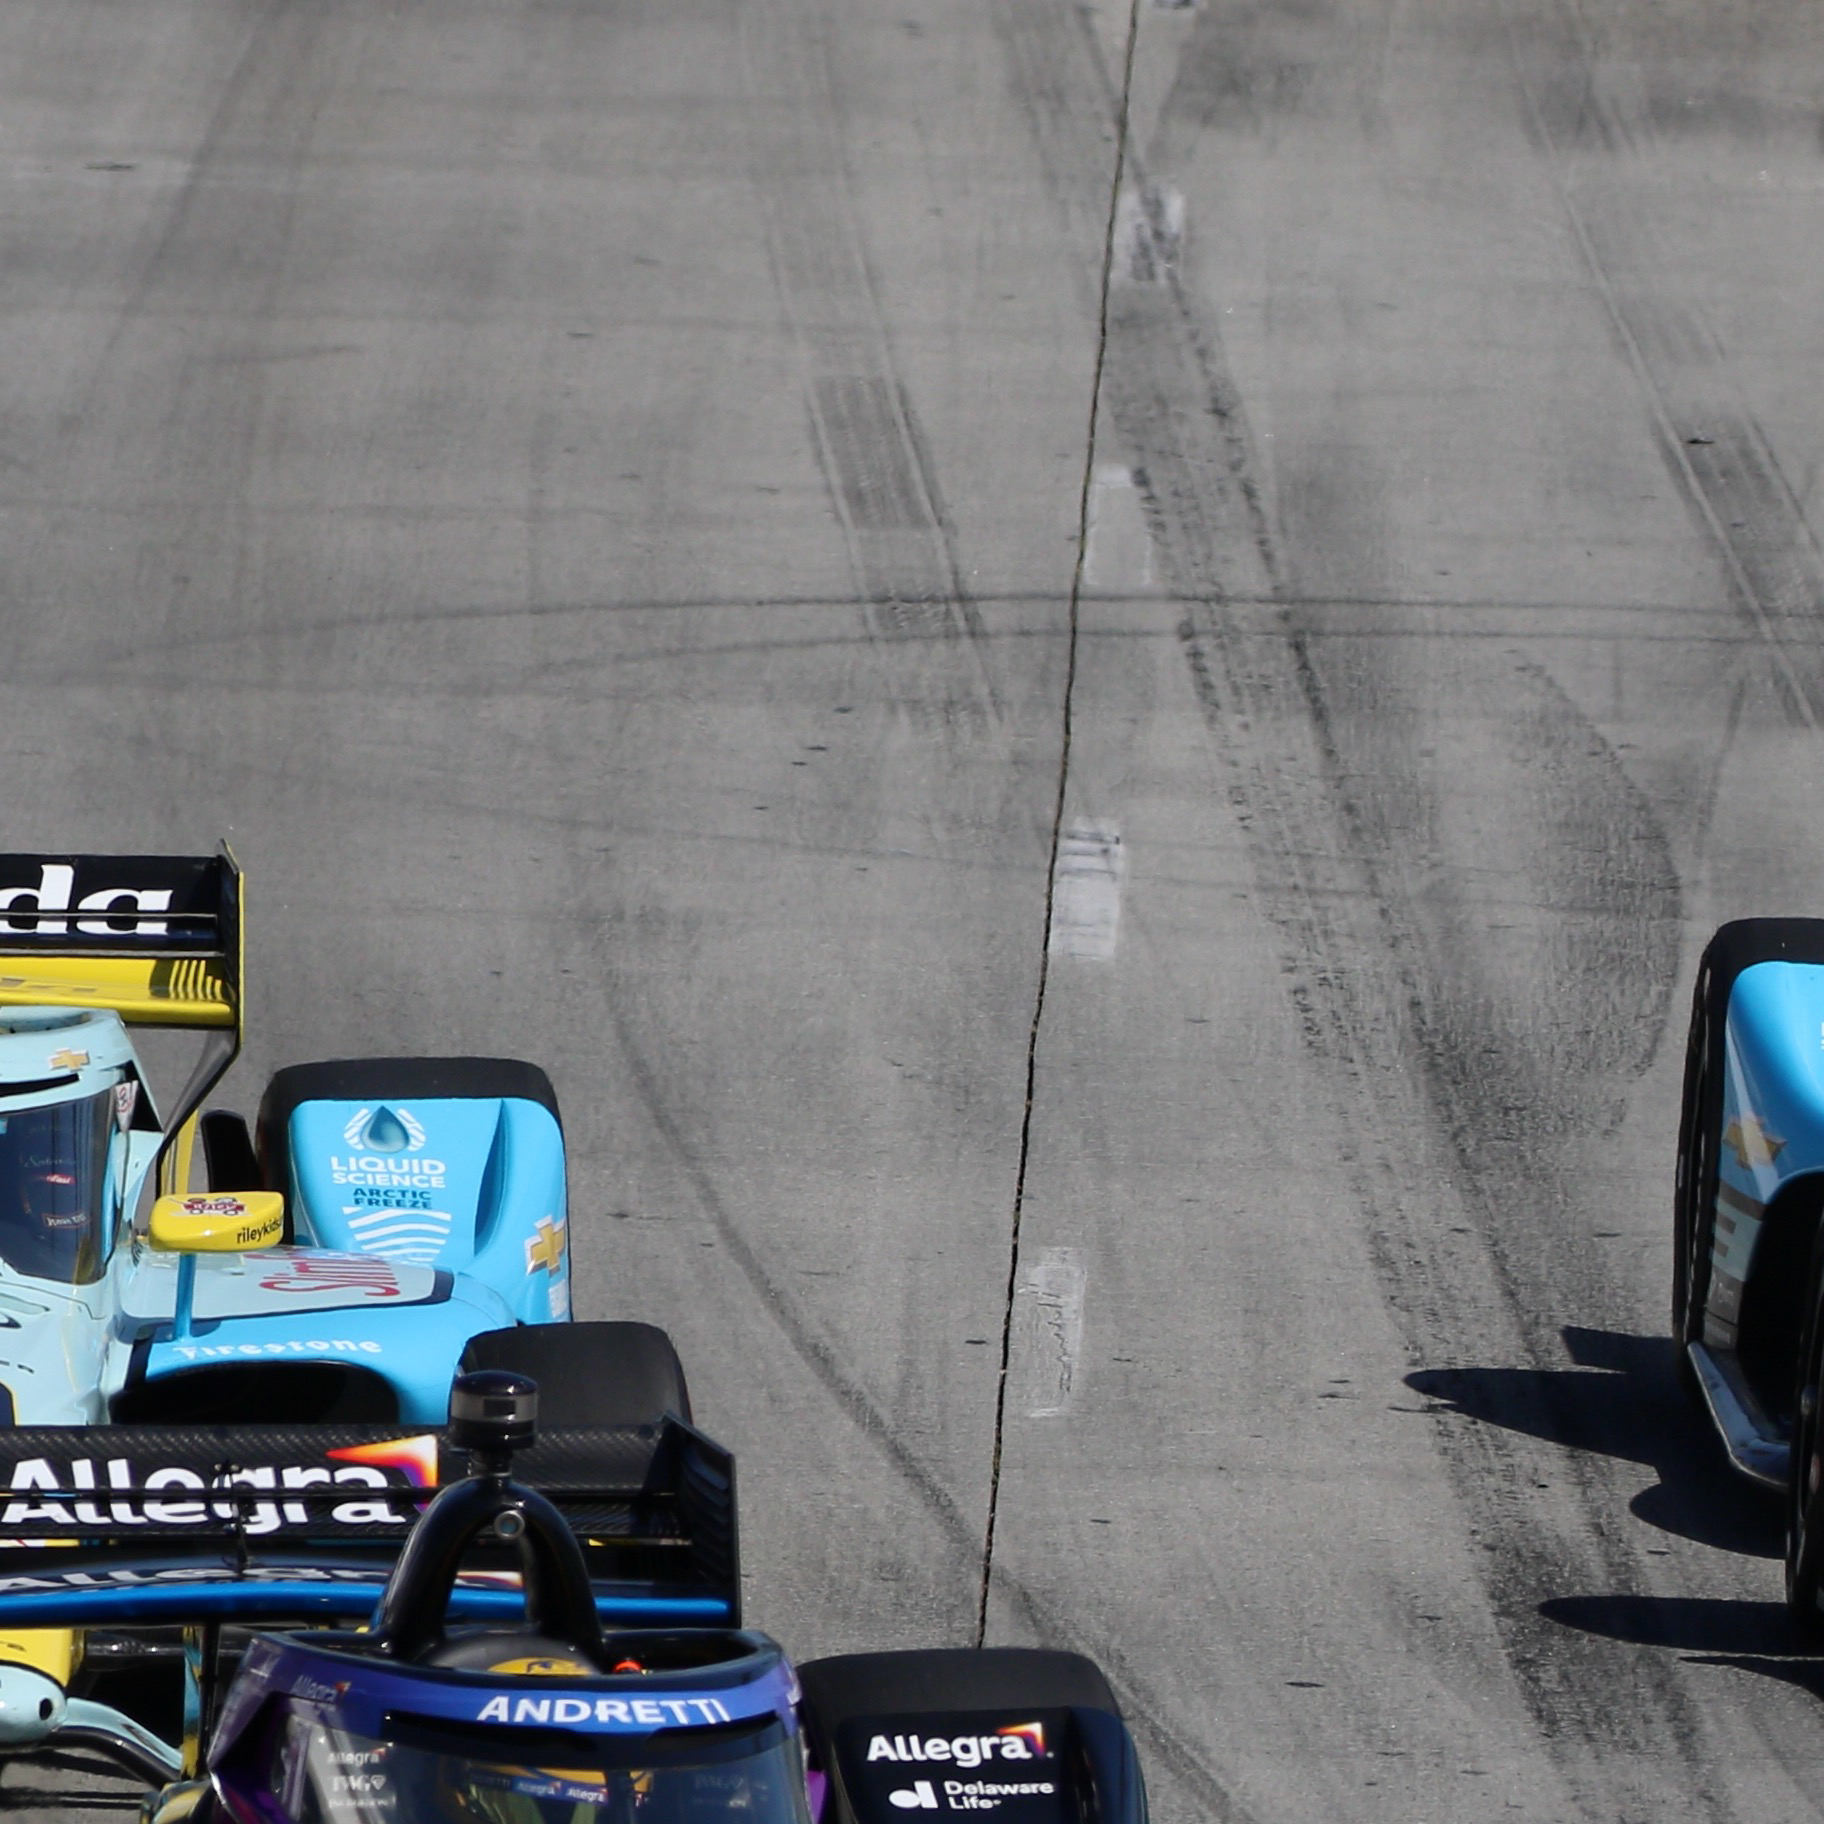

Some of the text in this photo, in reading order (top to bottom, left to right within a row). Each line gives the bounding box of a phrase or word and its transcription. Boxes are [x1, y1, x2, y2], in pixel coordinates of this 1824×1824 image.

[330, 1156, 447, 1176] LIQUID
[332, 1172, 447, 1189] SCIENCE
[352, 1187, 433, 1201] ARCTIC
[352, 1197, 433, 1211] FREEZE
[172, 1338, 384, 1361] Firestone
[1, 1457, 408, 1535] Allegra
[476, 1695, 732, 1725] ANDRETTI
[866, 1732, 1031, 1768] Allegra
[943, 1780, 1056, 1797] Delaware
[947, 1796, 994, 1810] Life
